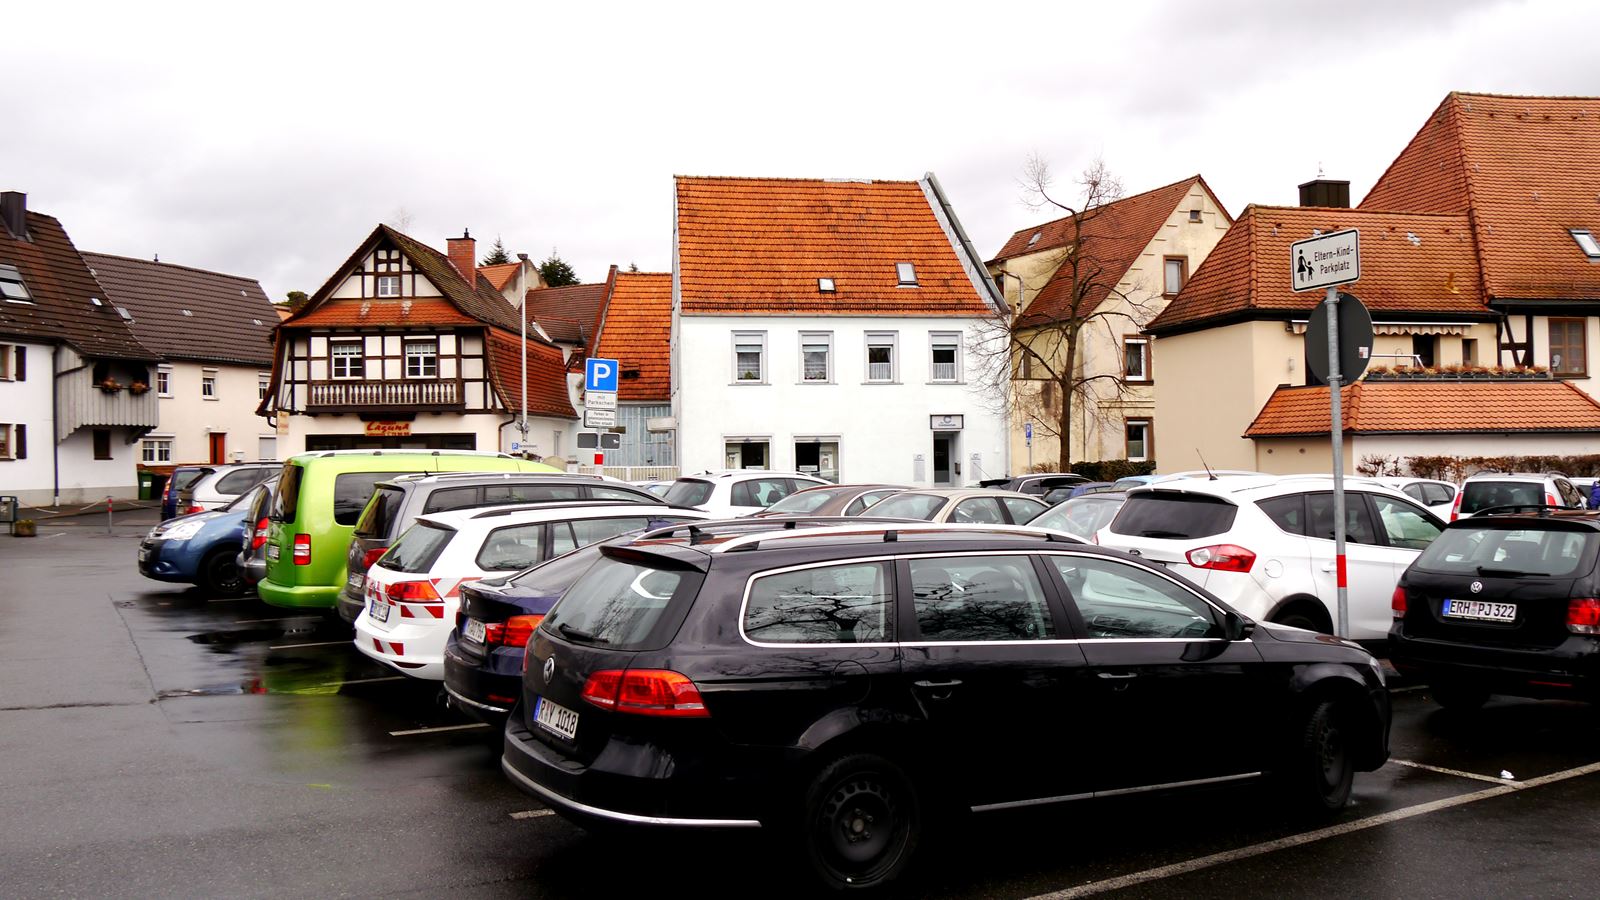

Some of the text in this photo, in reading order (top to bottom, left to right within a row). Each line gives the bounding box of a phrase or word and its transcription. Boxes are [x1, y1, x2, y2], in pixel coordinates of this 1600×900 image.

[1314, 245, 1354, 262] Eltern-Kind-
[1320, 261, 1350, 274] Parkplatz
[593, 363, 611, 387] P
[367, 420, 410, 433] Laguna
[1450, 601, 1515, 618] ERH PJ 322
[540, 700, 546, 719] R
[548, 704, 556, 724] Y
[555, 709, 577, 735] 1018
